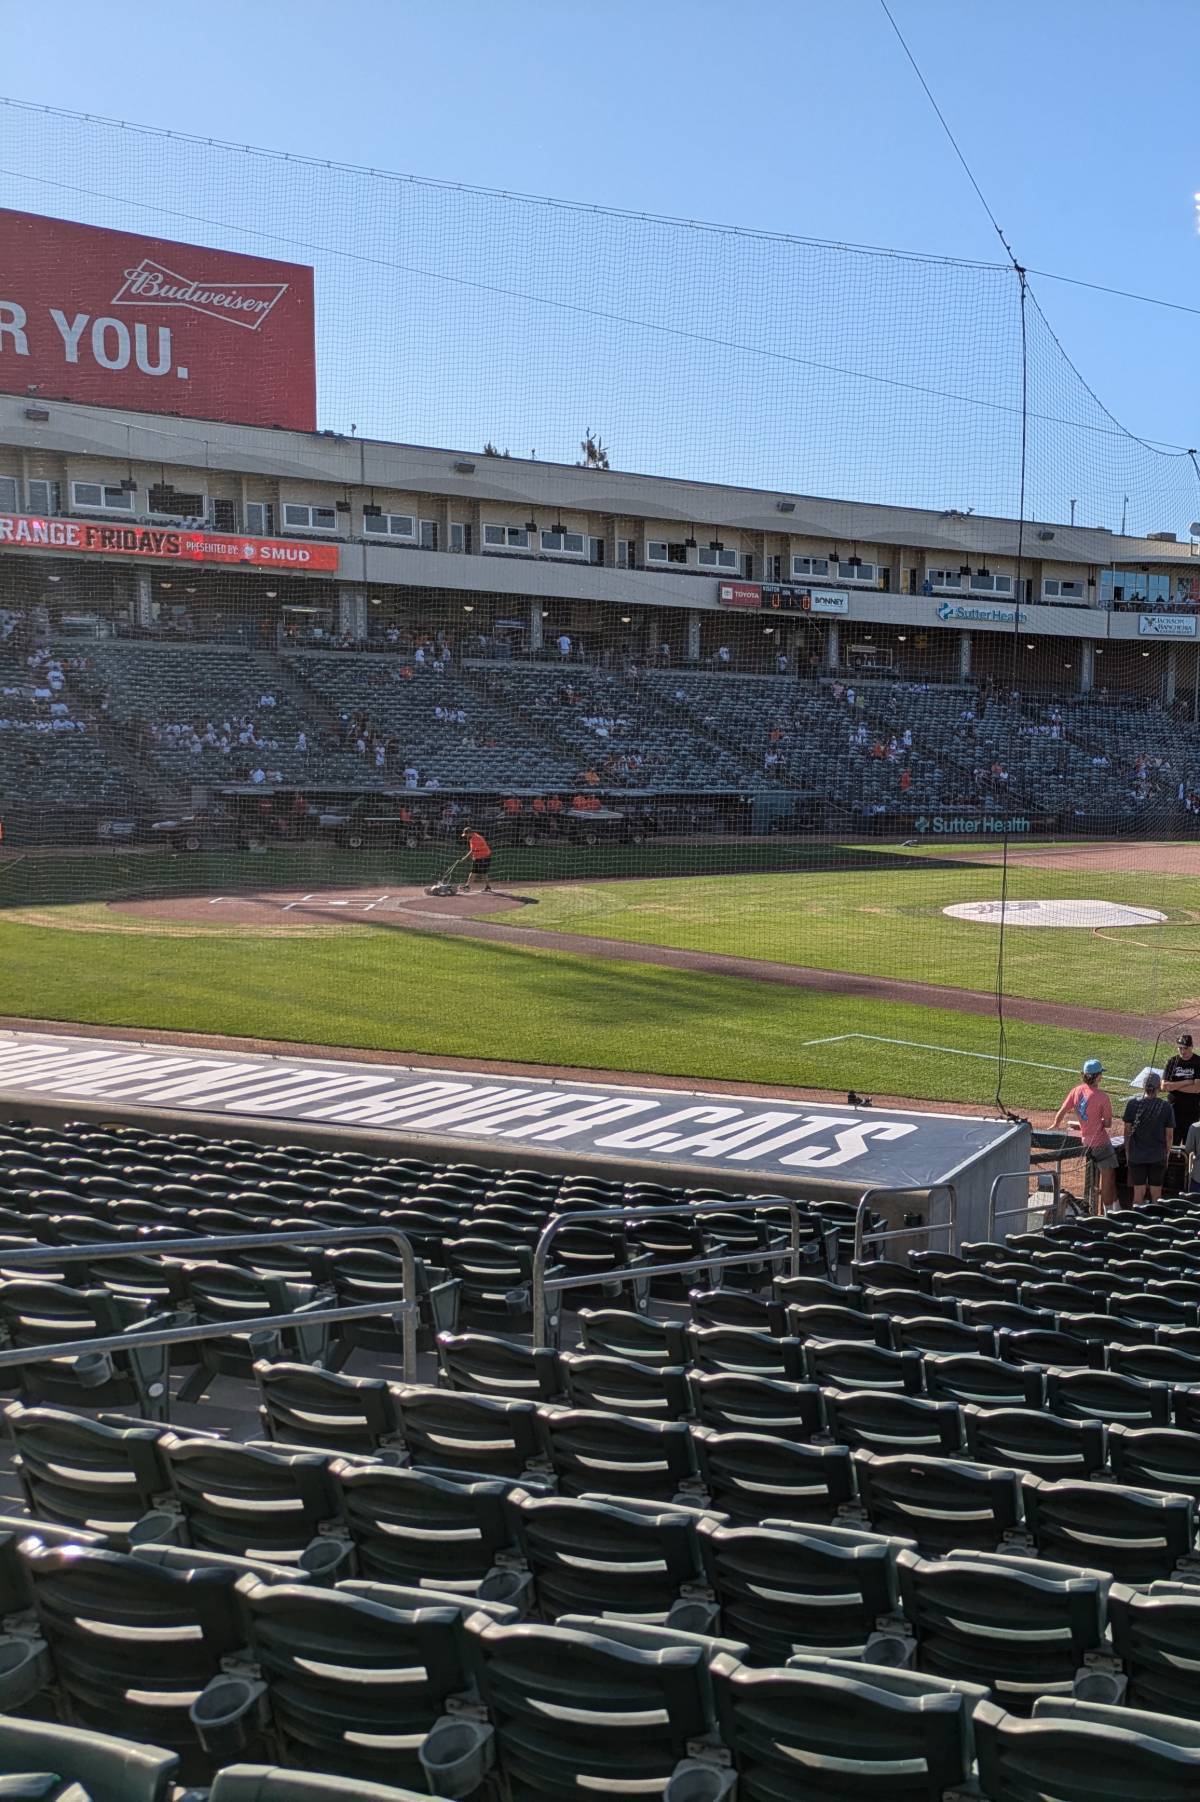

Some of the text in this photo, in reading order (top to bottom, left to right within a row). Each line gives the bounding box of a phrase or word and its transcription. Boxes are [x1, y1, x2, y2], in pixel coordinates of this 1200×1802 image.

[124, 267, 271, 313] Budweiser
[49, 308, 189, 380] YOU.
[0, 518, 81, 547] RANGE
[85, 525, 182, 556] FRIDAYS
[186, 540, 227, 554] PRESENTED
[260, 547, 311, 562] SMUD
[734, 591, 759, 599] TOYOTA
[815, 597, 844, 605] BONNEY
[957, 606, 1027, 623] Sutter Heath
[932, 816, 1031, 833] Sutter Health
[299, 1081, 662, 1141] RIVER
[594, 1106, 919, 1168] CATS
